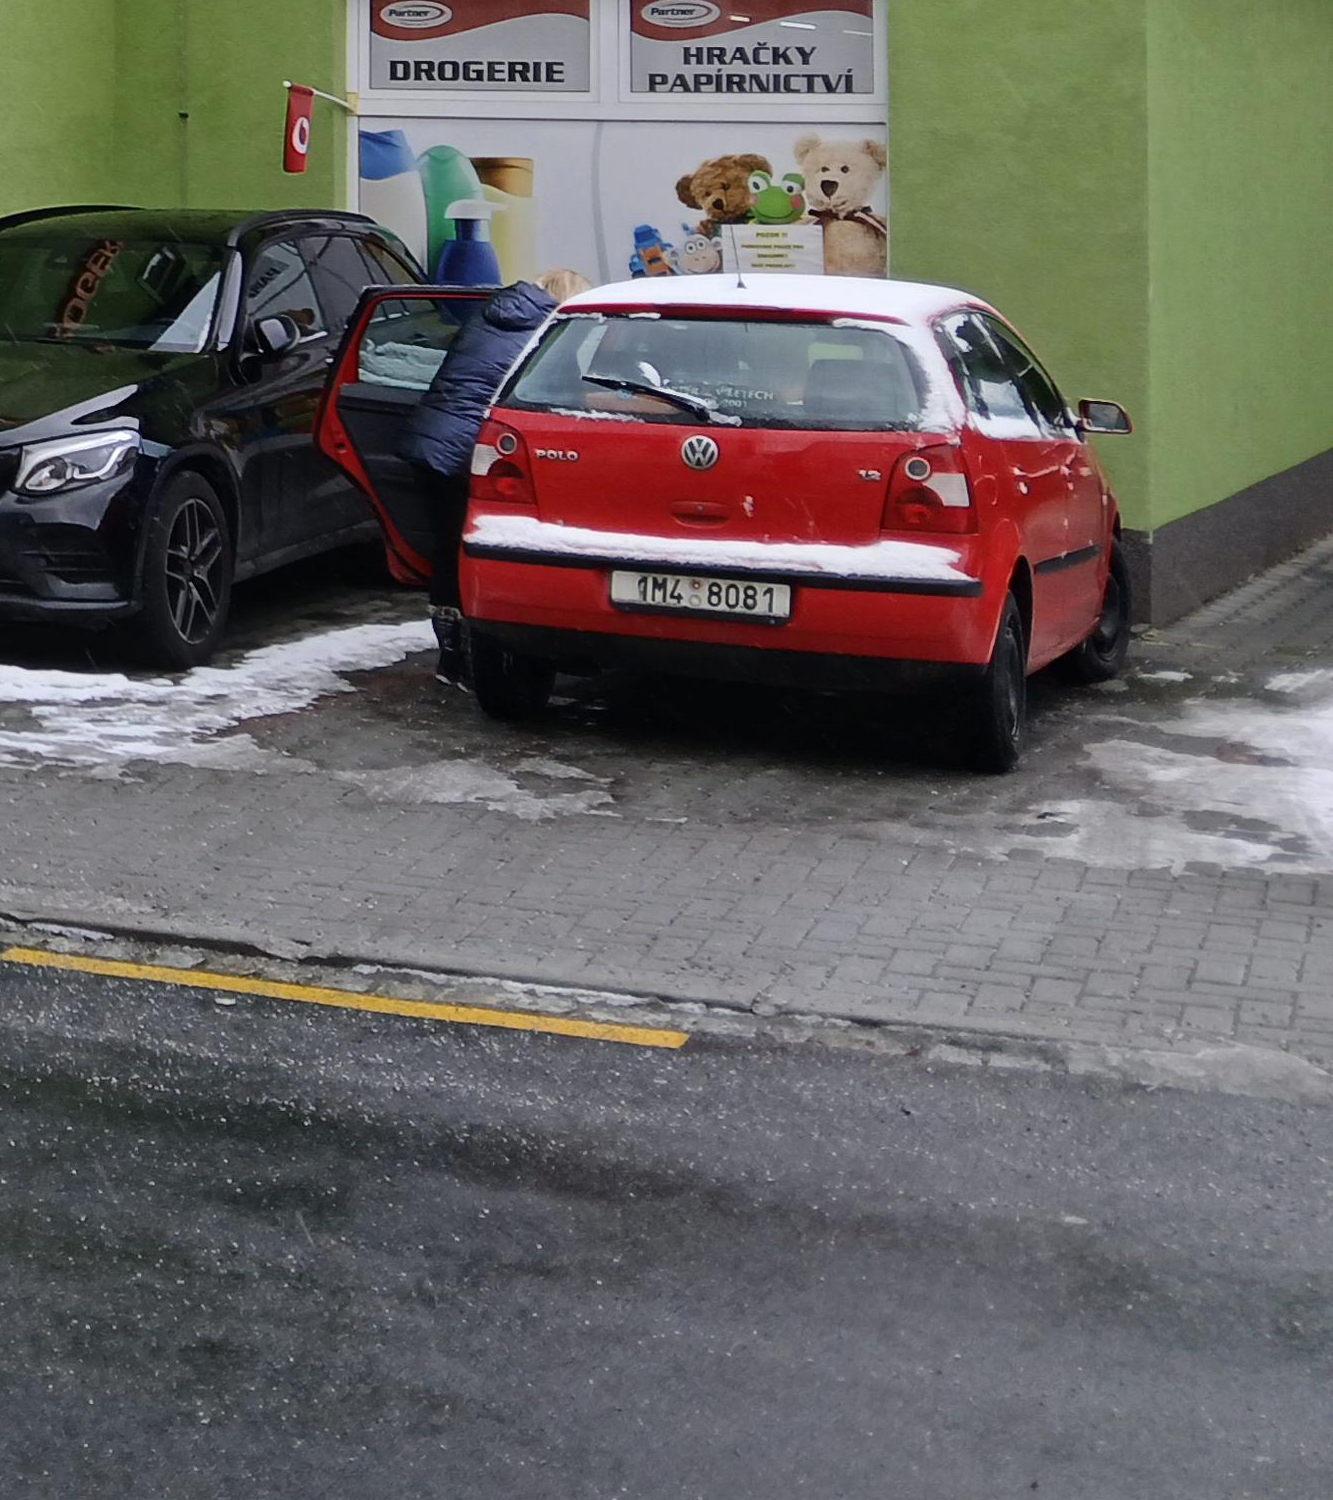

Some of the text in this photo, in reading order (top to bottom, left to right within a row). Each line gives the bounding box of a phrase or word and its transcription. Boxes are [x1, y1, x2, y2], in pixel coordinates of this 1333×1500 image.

[388, 9, 430, 17] Partner
[650, 7, 696, 16] Partner
[683, 41, 817, 66] HRAČKY
[389, 60, 566, 83] DROGERIE
[647, 68, 854, 94] PAPÍRNICTVÍ
[535, 449, 579, 461] POLO
[637, 576, 774, 613] 1M4 8081
